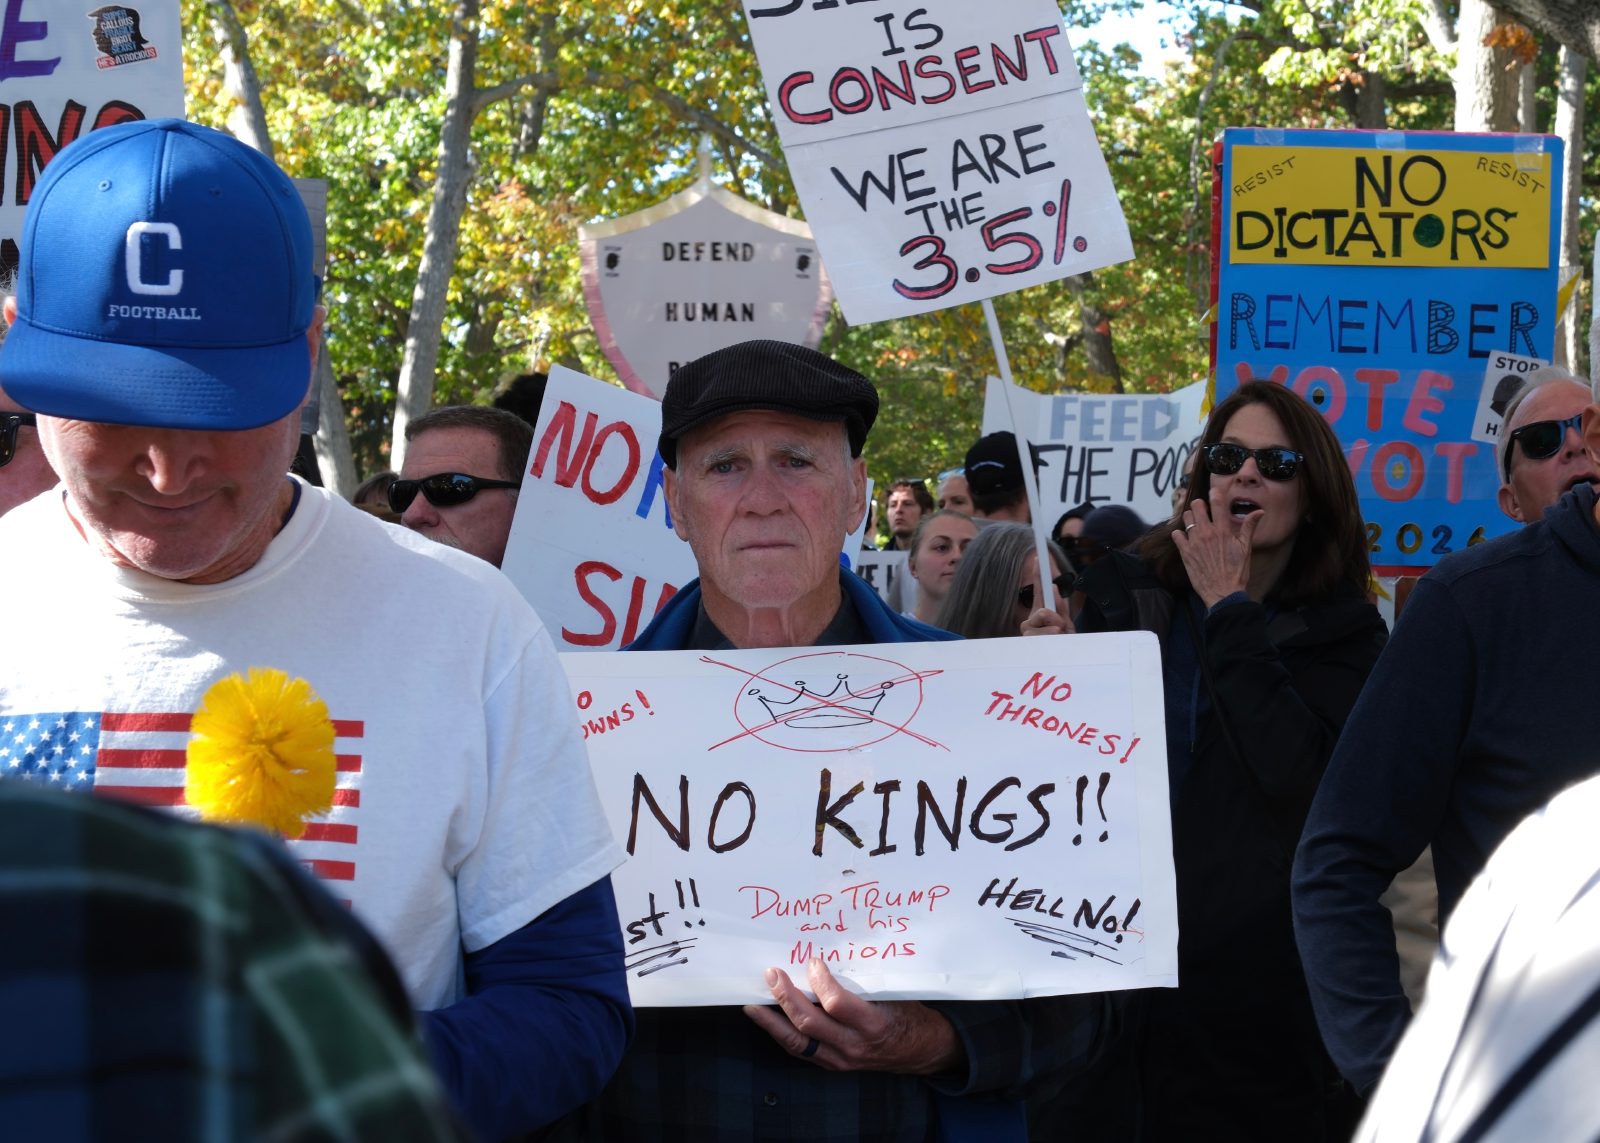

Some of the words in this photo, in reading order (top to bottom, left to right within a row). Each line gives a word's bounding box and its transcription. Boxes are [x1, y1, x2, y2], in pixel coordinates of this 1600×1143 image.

[101, 17, 134, 30] CALLOUS
[111, 34, 133, 45] BIGOT
[873, 8, 944, 56] IS
[111, 42, 137, 54] SEXIST
[778, 25, 1060, 124] CONSENT
[830, 147, 936, 212] WE
[952, 124, 1055, 191] ARE
[1233, 155, 1296, 197] RESIST
[1355, 155, 1447, 208] NO
[1476, 156, 1545, 193] RESIST
[904, 191, 985, 235] THE
[1236, 207, 1519, 260] DICTATORS
[125, 221, 184, 296] C
[663, 242, 755, 262] DEFEND
[893, 179, 1088, 300] 3.5%
[107, 304, 202, 321] FOOTBALL
[665, 303, 755, 322] HUMAN
[1230, 292, 1539, 359] REMEMBER
[1495, 356, 1540, 373] STOP
[1050, 396, 1181, 442] FEED
[530, 400, 641, 506] NO
[1127, 436, 1201, 502] POO
[1020, 671, 1072, 702] NO
[984, 691, 1141, 764] THRONES!
[626, 771, 757, 858] NO
[812, 767, 1112, 858] KINGS!!
[841, 881, 950, 912] TRUMP
[977, 876, 1065, 919] HELL
[800, 910, 849, 932] and
[869, 908, 910, 933] his
[790, 940, 917, 965] Minions
